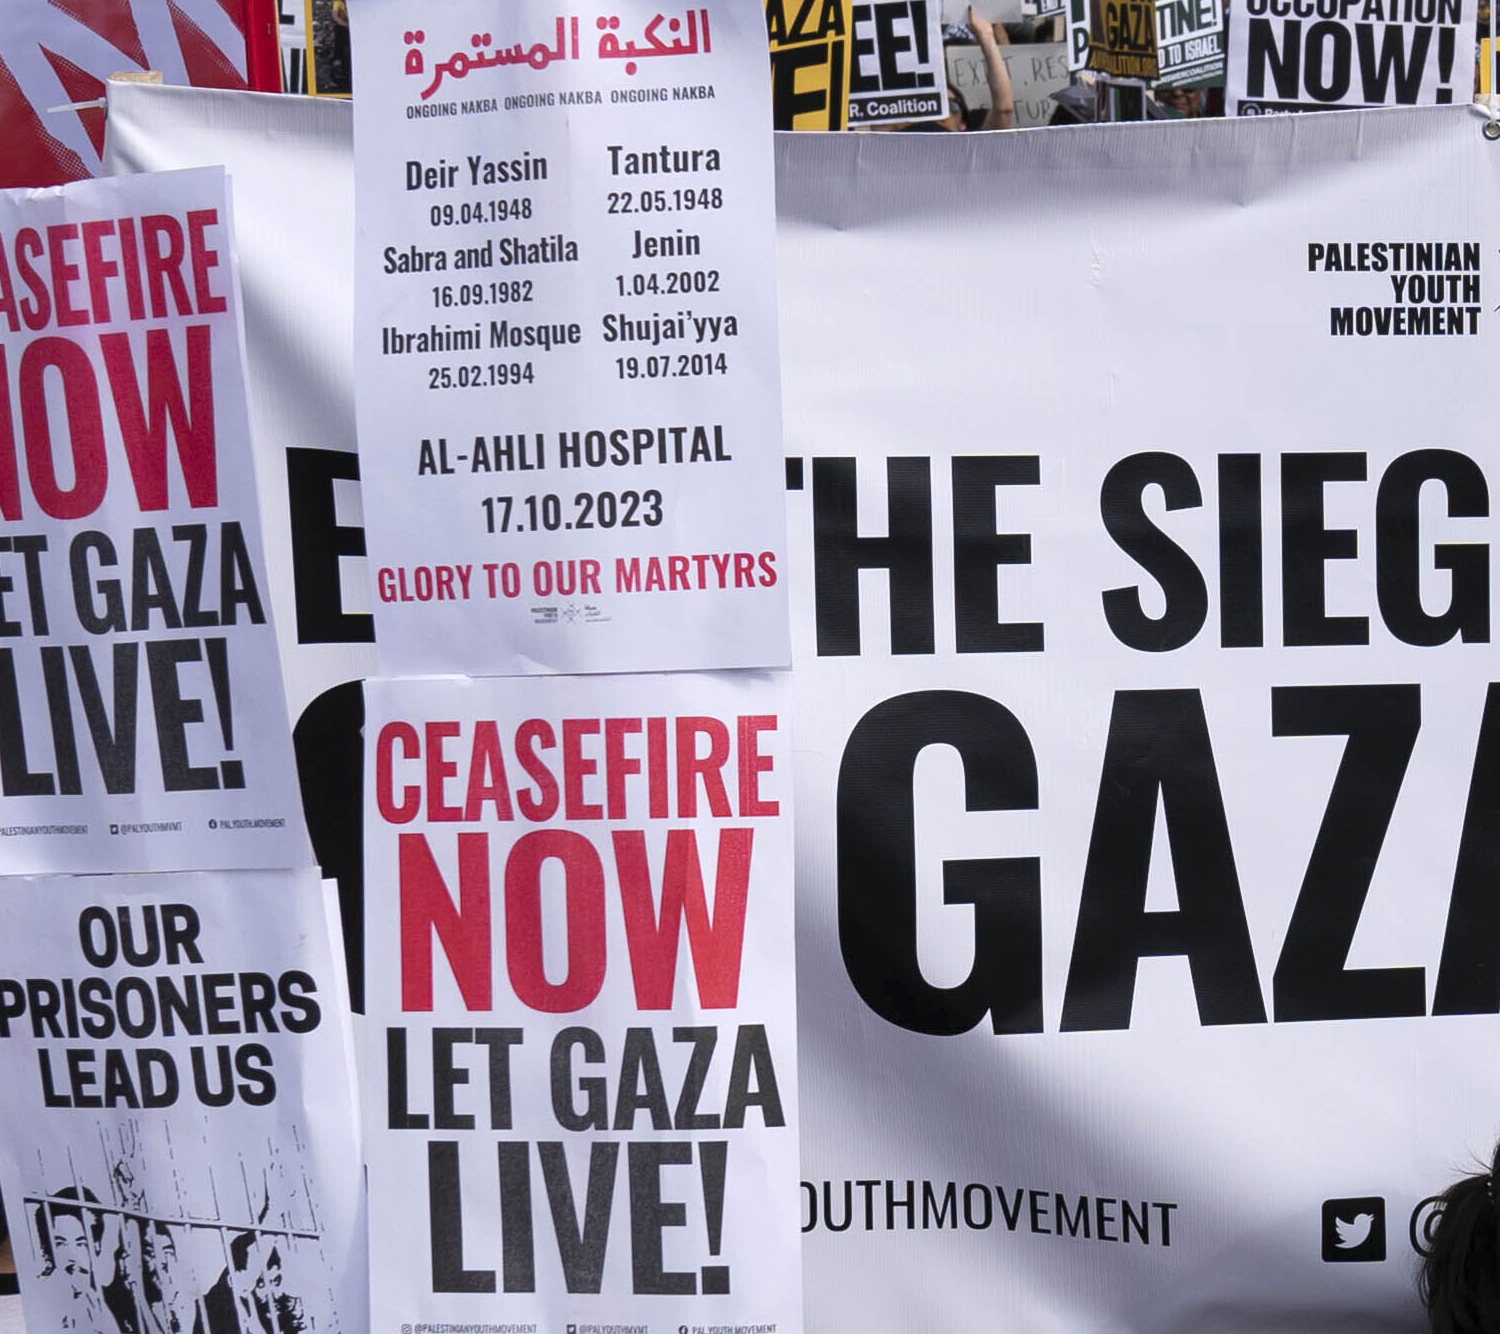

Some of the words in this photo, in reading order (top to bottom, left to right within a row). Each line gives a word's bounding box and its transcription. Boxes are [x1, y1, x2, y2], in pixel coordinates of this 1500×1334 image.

[405, 16, 579, 101] المستمرة
[596, 9, 711, 76] النكبة
[1247, 19, 1455, 105] NOW!
[406, 102, 458, 118] ONGOING
[461, 99, 499, 114] NAKBA
[504, 94, 556, 110] ONGOING
[559, 91, 602, 107] NAKBA
[610, 88, 669, 104] ONGOING
[672, 86, 715, 100] NAKBA
[405, 158, 459, 190] Deir
[467, 153, 547, 187] Yassin
[606, 144, 720, 177] Tantura
[430, 197, 532, 226] 09.04.1948
[606, 187, 723, 215] 22.05.1948
[384, 244, 446, 274] Sabra
[454, 241, 493, 270] and
[499, 233, 578, 267] Shatila
[631, 228, 701, 261] Jenin
[1308, 243, 1480, 272] PALESTINIAN
[431, 280, 533, 308] 16.09.1982
[615, 270, 720, 297] 1.04.2002
[1391, 276, 1480, 303] YOUTH
[382, 323, 482, 356] Ibrahimi
[489, 319, 581, 352] Mosque
[1330, 306, 1481, 336] MOVEMENT
[428, 362, 534, 390] 25.02.1994
[615, 353, 727, 380] 19.07.2014
[417, 436, 545, 476] AL-AHLI
[558, 426, 732, 467] HOSPITAL
[480, 490, 663, 532] 17.10.2023
[378, 567, 471, 605] GLORY
[480, 565, 522, 599] TO
[532, 561, 602, 597] OUR
[613, 552, 777, 594] MARTYRS
[376, 715, 780, 825] CEASEFIRE
[79, 904, 202, 969] OUR
[398, 828, 754, 1014] NOW
[40, 1045, 178, 1111] LEAD
[196, 1044, 276, 1108] US
[387, 1027, 522, 1131] LET
[551, 1023, 785, 1131] GAZA
[428, 1140, 730, 1295] LIVE!
